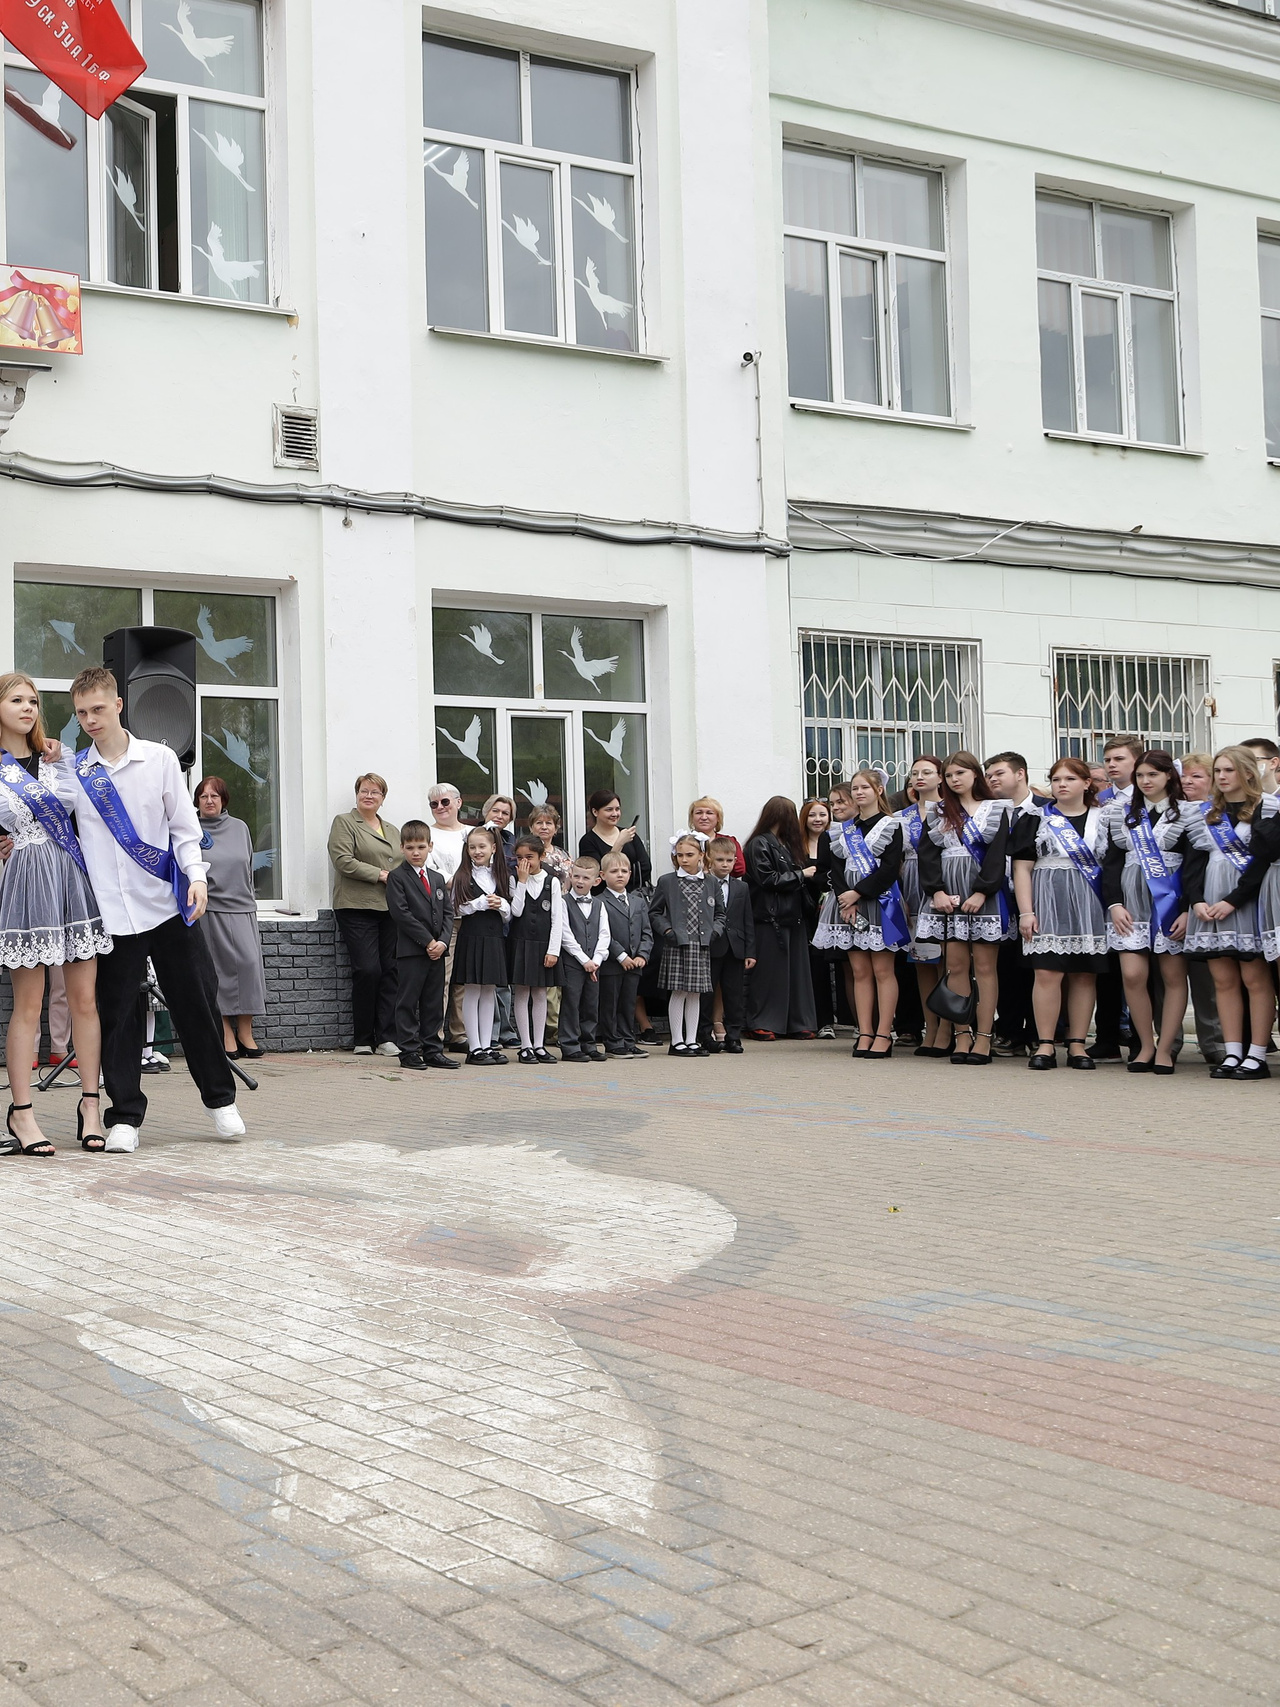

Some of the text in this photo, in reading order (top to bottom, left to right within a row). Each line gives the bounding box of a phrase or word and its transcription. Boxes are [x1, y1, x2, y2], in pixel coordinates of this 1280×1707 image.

[91, 777, 132, 844] Выпускник
[131, 843, 164, 866] 2025
[1146, 856, 1166, 878] 2025
